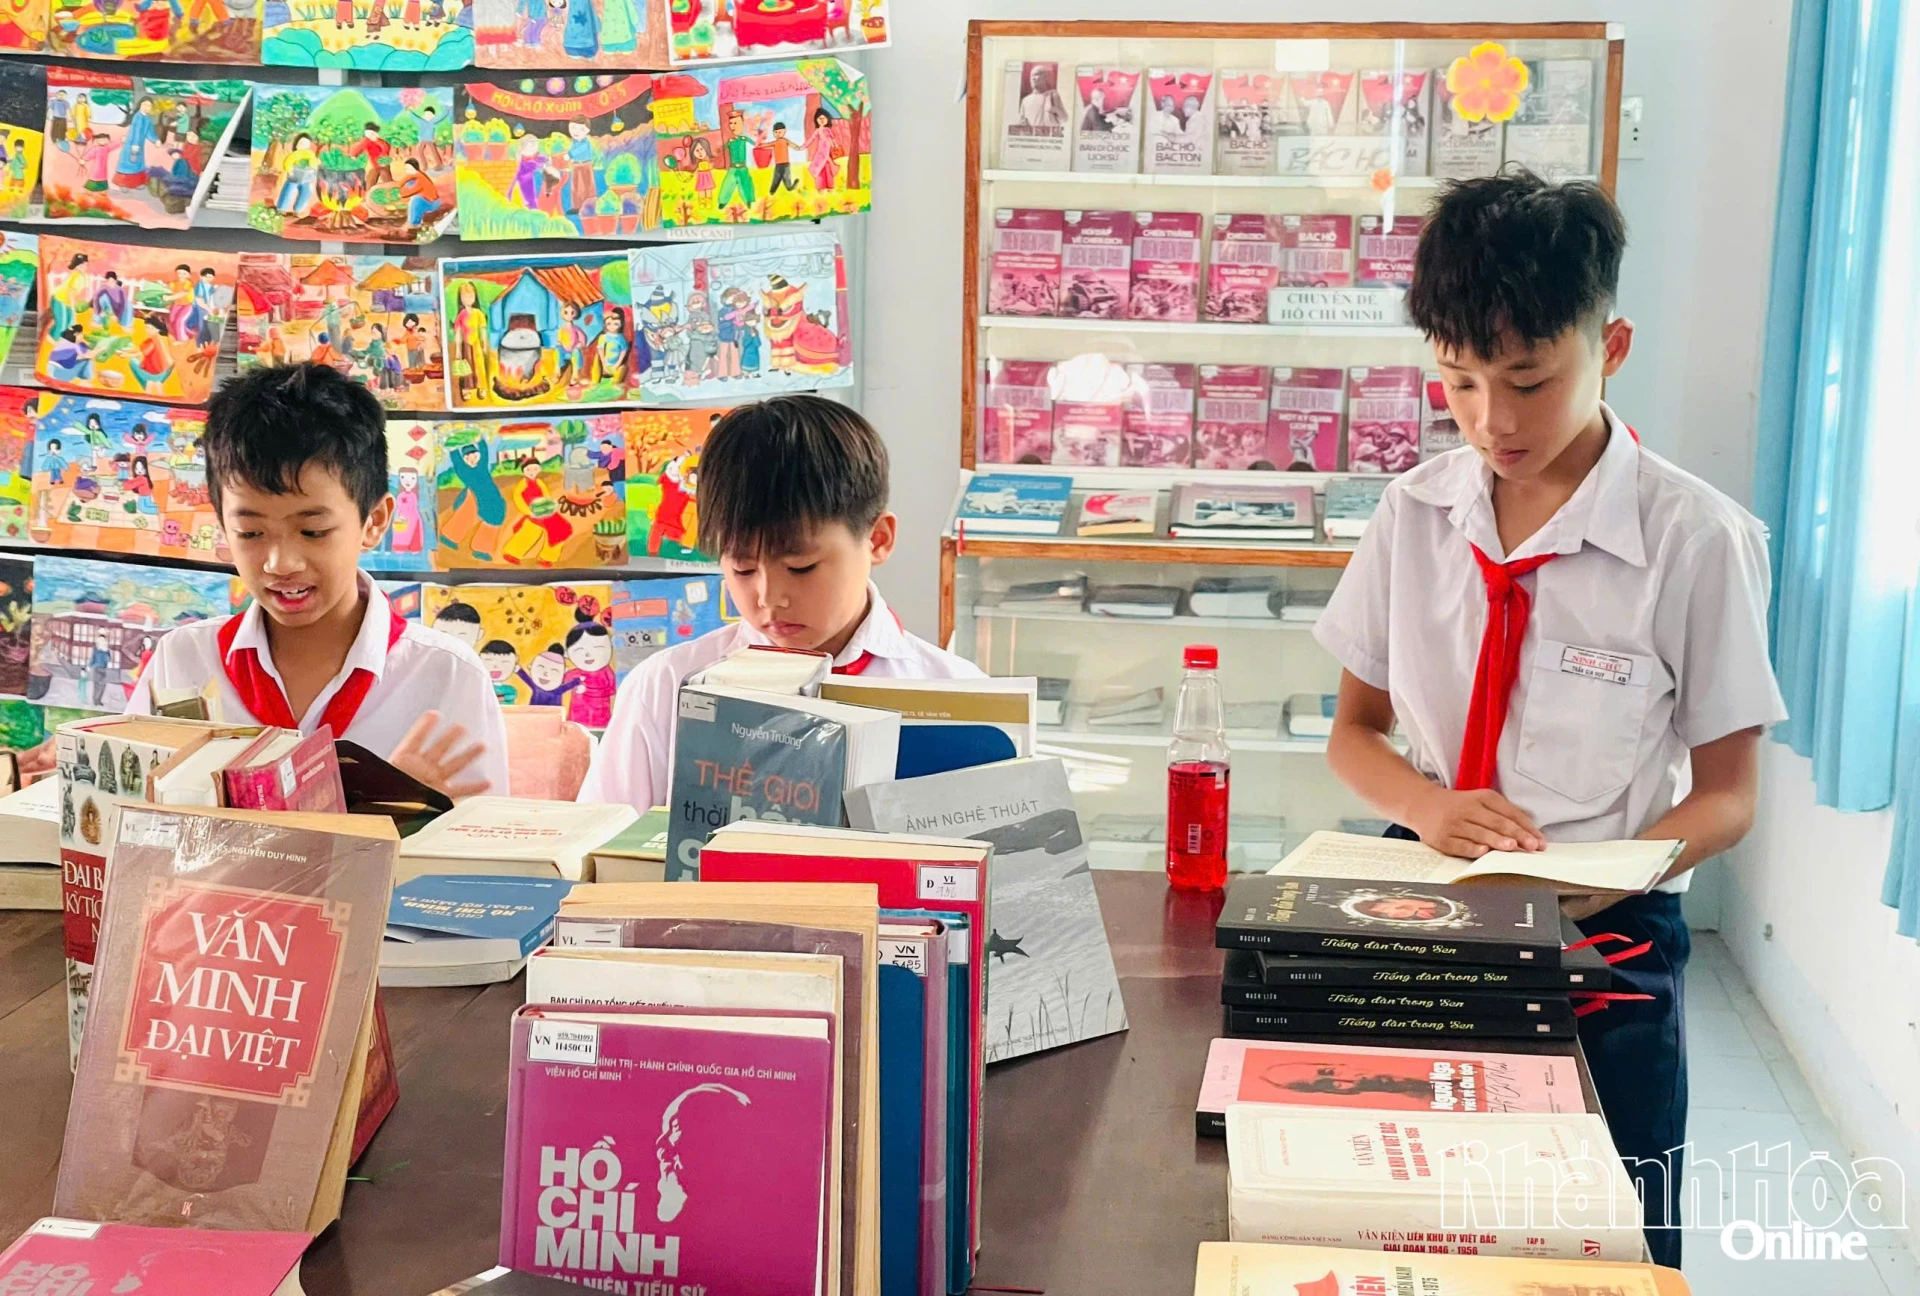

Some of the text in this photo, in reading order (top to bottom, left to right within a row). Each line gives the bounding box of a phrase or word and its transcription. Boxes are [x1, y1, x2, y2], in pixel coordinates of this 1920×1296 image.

[1287, 291, 1351, 305] CHUYÊN
[1281, 306, 1383, 321] HỒ CHÍ MINH
[1571, 655, 1596, 667] NINH
[684, 801, 728, 826] thời
[942, 805, 987, 825] NGHỆ
[267, 850, 285, 860] DUY
[286, 854, 307, 863] HINH
[64, 860, 91, 890] ĐẠI
[943, 875, 956, 883] VL
[188, 909, 298, 967] VĂN
[561, 935, 577, 947] VL
[895, 944, 916, 955] VN
[1321, 938, 1457, 955] Tiếng đàn trong Sen
[1372, 971, 1508, 983] Tiếng đàn trong Sen
[150, 962, 307, 1023] MINH
[1328, 993, 1465, 1008] Tiếng đàn trong Sen
[1338, 1017, 1475, 1031] Tiếng đàn trong Sen
[145, 1019, 300, 1072] ĐẠI VIỆT
[534, 1034, 551, 1046] VN
[555, 1042, 592, 1053] H450CH
[545, 1065, 622, 1081] VIỆN HỒ CHÍ MINH
[640, 1059, 665, 1071] HÀNH
[667, 1060, 694, 1073] CHÍNH
[696, 1062, 722, 1076] QUỐC
[724, 1066, 740, 1077] GIA
[741, 1064, 755, 1078] HỒ
[757, 1067, 772, 1079] CHÍ
[774, 1071, 796, 1081] MINH
[1429, 1061, 1456, 1080] Nga
[539, 1134, 622, 1191] HỒ
[537, 1182, 640, 1233] CHÍ
[1358, 1230, 1379, 1241] VĂN
[1380, 1231, 1405, 1242] KIỆN
[1407, 1231, 1424, 1242] LIÊN
[1426, 1232, 1444, 1242] KHU
[1459, 1232, 1477, 1244] VIỆT
[534, 1225, 680, 1277] MINH
[1383, 1244, 1400, 1252] GIAI
[1428, 1245, 1449, 1254] 1946
[1457, 1246, 1478, 1255] 1956
